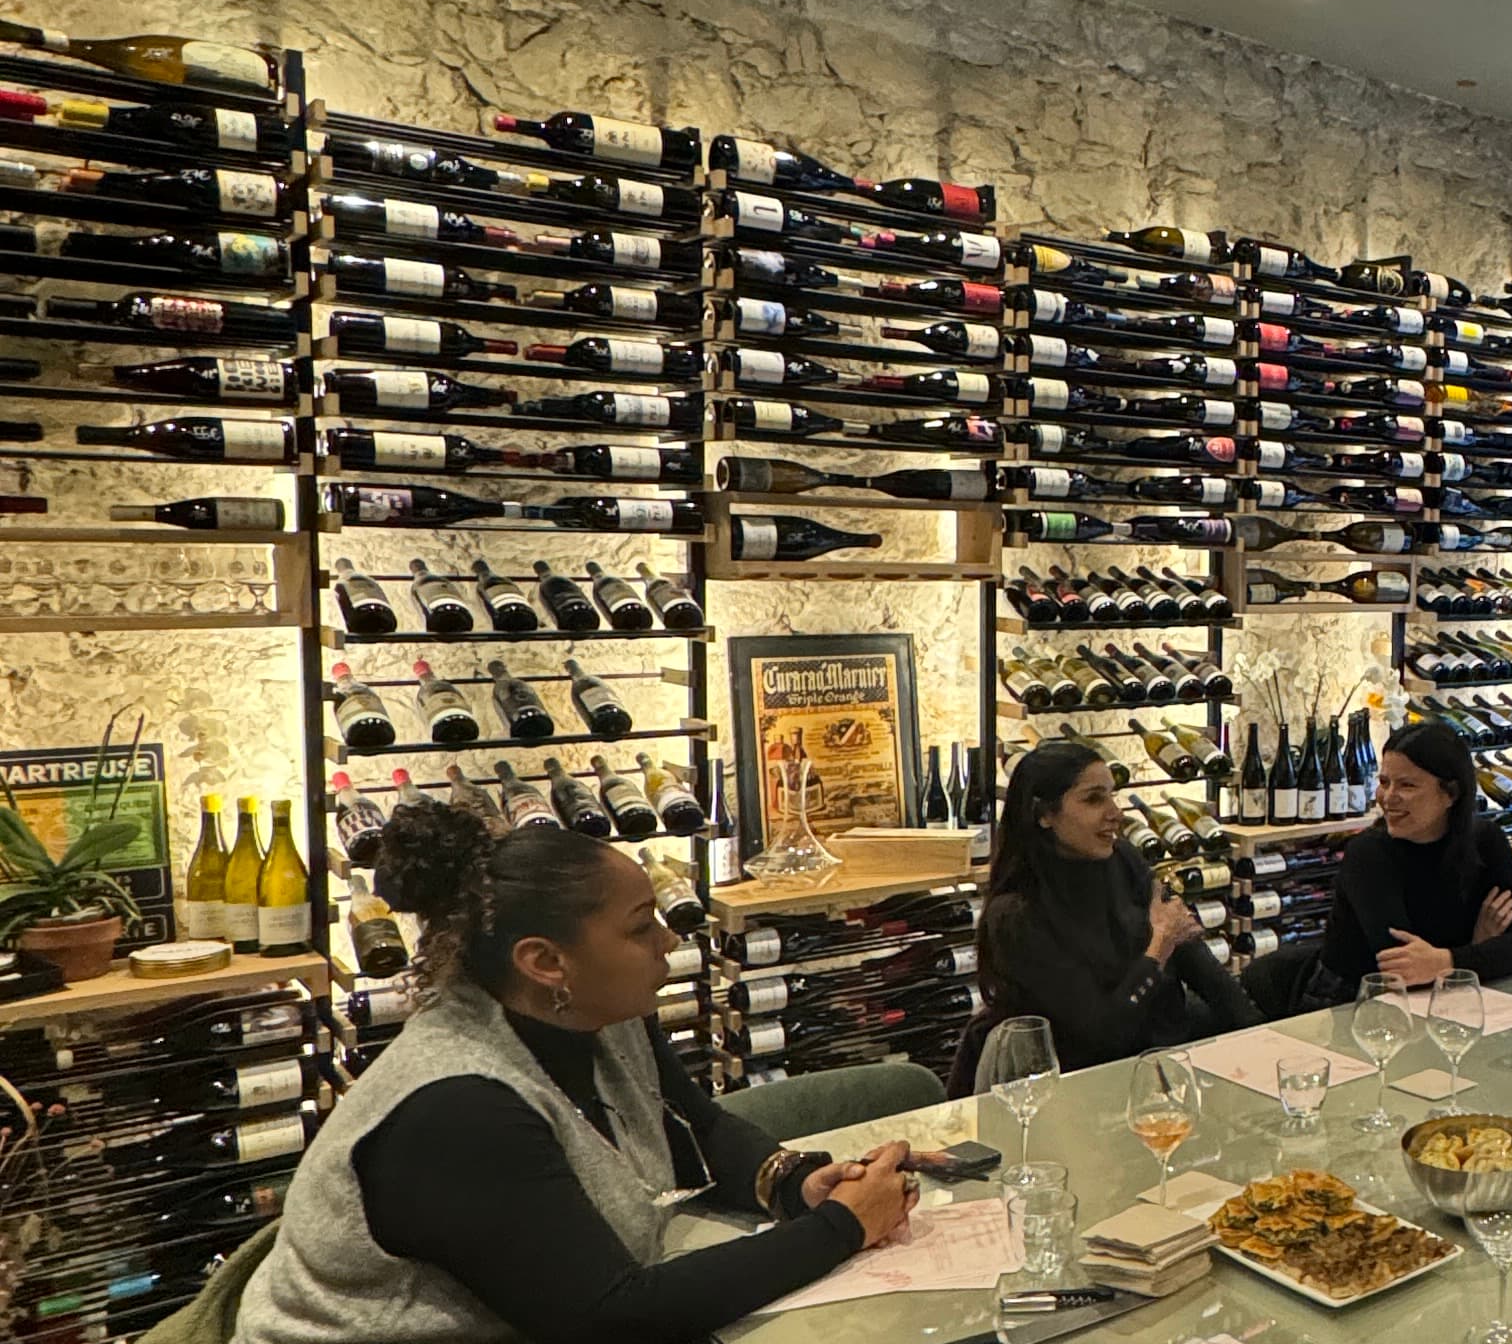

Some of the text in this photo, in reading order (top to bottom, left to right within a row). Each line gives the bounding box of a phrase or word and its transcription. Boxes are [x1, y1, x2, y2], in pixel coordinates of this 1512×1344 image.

[822, 662, 886, 692] Marnier
[788, 690, 865, 706] Triple Orange
